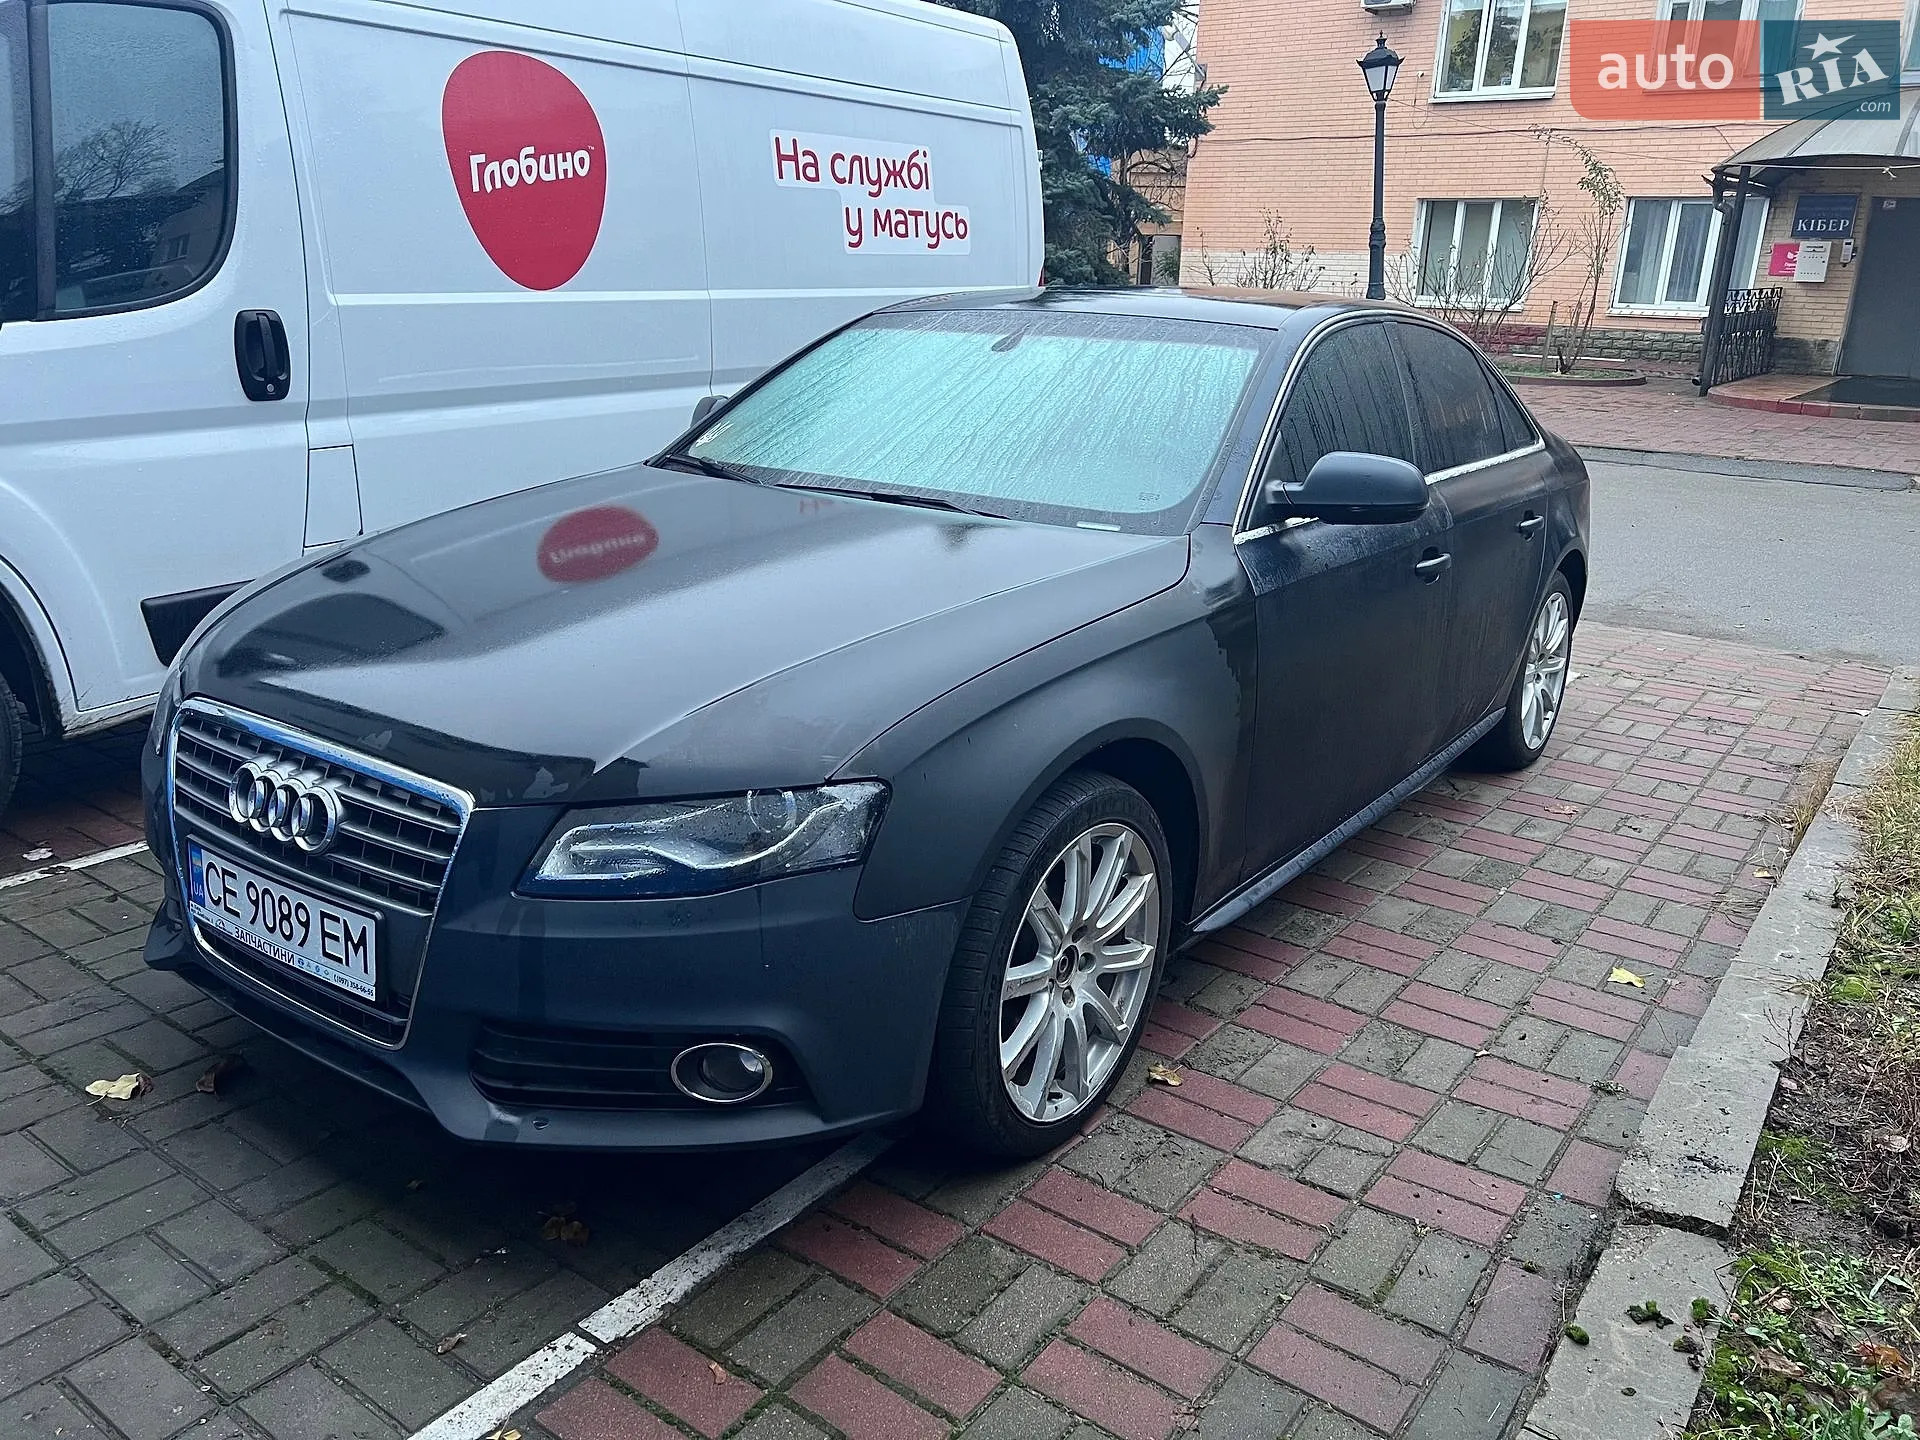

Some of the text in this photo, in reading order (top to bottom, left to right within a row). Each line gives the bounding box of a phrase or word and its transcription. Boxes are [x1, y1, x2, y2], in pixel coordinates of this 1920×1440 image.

[469, 146, 591, 194] Глобино
[775, 136, 930, 198] На службі
[845, 207, 968, 249] у матусь
[1796, 219, 1850, 231] КІБЕР
[193, 882, 204, 898] UA
[246, 880, 311, 948] 9089
[234, 926, 295, 966] ЗАПЧАСТИНИ
